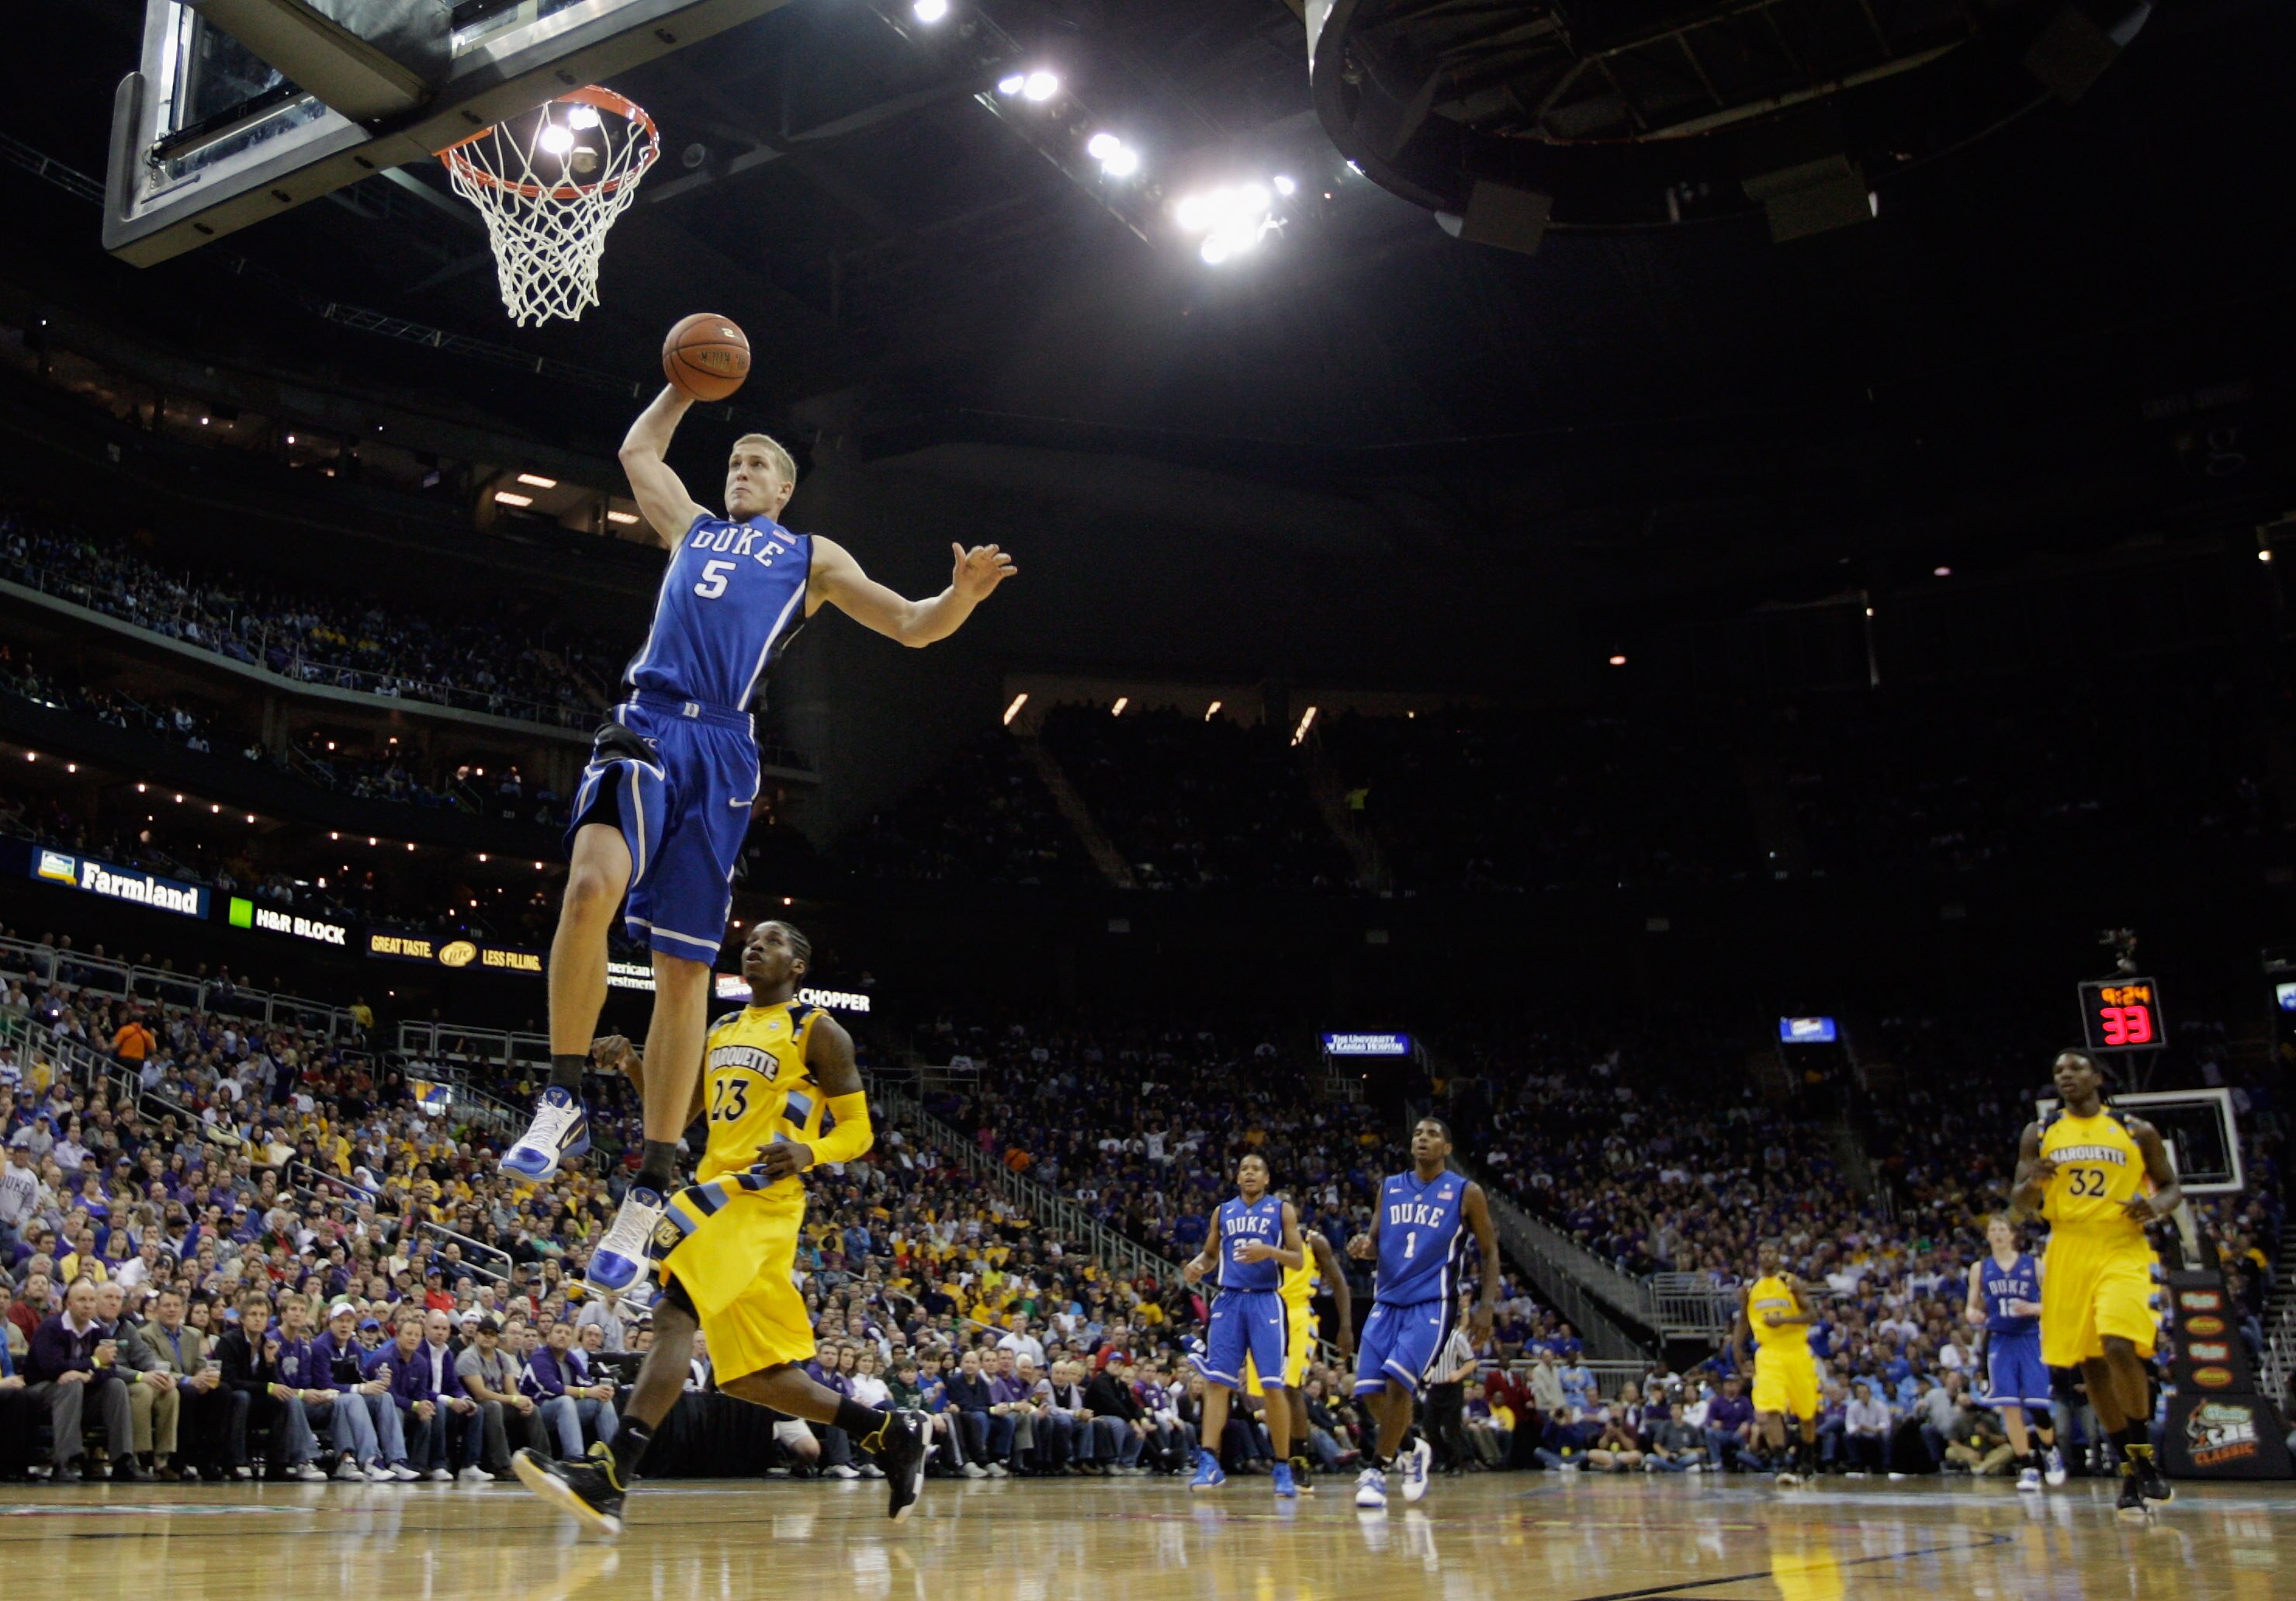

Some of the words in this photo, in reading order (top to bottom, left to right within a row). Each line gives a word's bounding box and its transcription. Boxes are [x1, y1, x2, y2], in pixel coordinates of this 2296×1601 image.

[690, 528, 785, 567] DUKE
[694, 559, 736, 599] 5
[81, 861, 199, 914] Farmland
[256, 908, 292, 933] H&R
[293, 917, 346, 945] BLOCK
[371, 934, 402, 955] GREAT
[402, 938, 433, 958] TASTE.
[482, 949, 506, 968] LESS
[506, 951, 542, 971] FILLING.
[798, 987, 871, 1012] CHOPPER
[2100, 986, 2151, 1006] 9:24
[2100, 1005, 2152, 1045] 33
[712, 1079, 750, 1121] 23
[2048, 1145, 2126, 1167] MARQUETTE
[2068, 1167, 2105, 1197] 32
[1226, 1215, 1272, 1235] DUKE
[1389, 1203, 1445, 1228] DUKE
[1404, 1231, 1416, 1259] 1
[1988, 1278, 2030, 1297] DUKE
